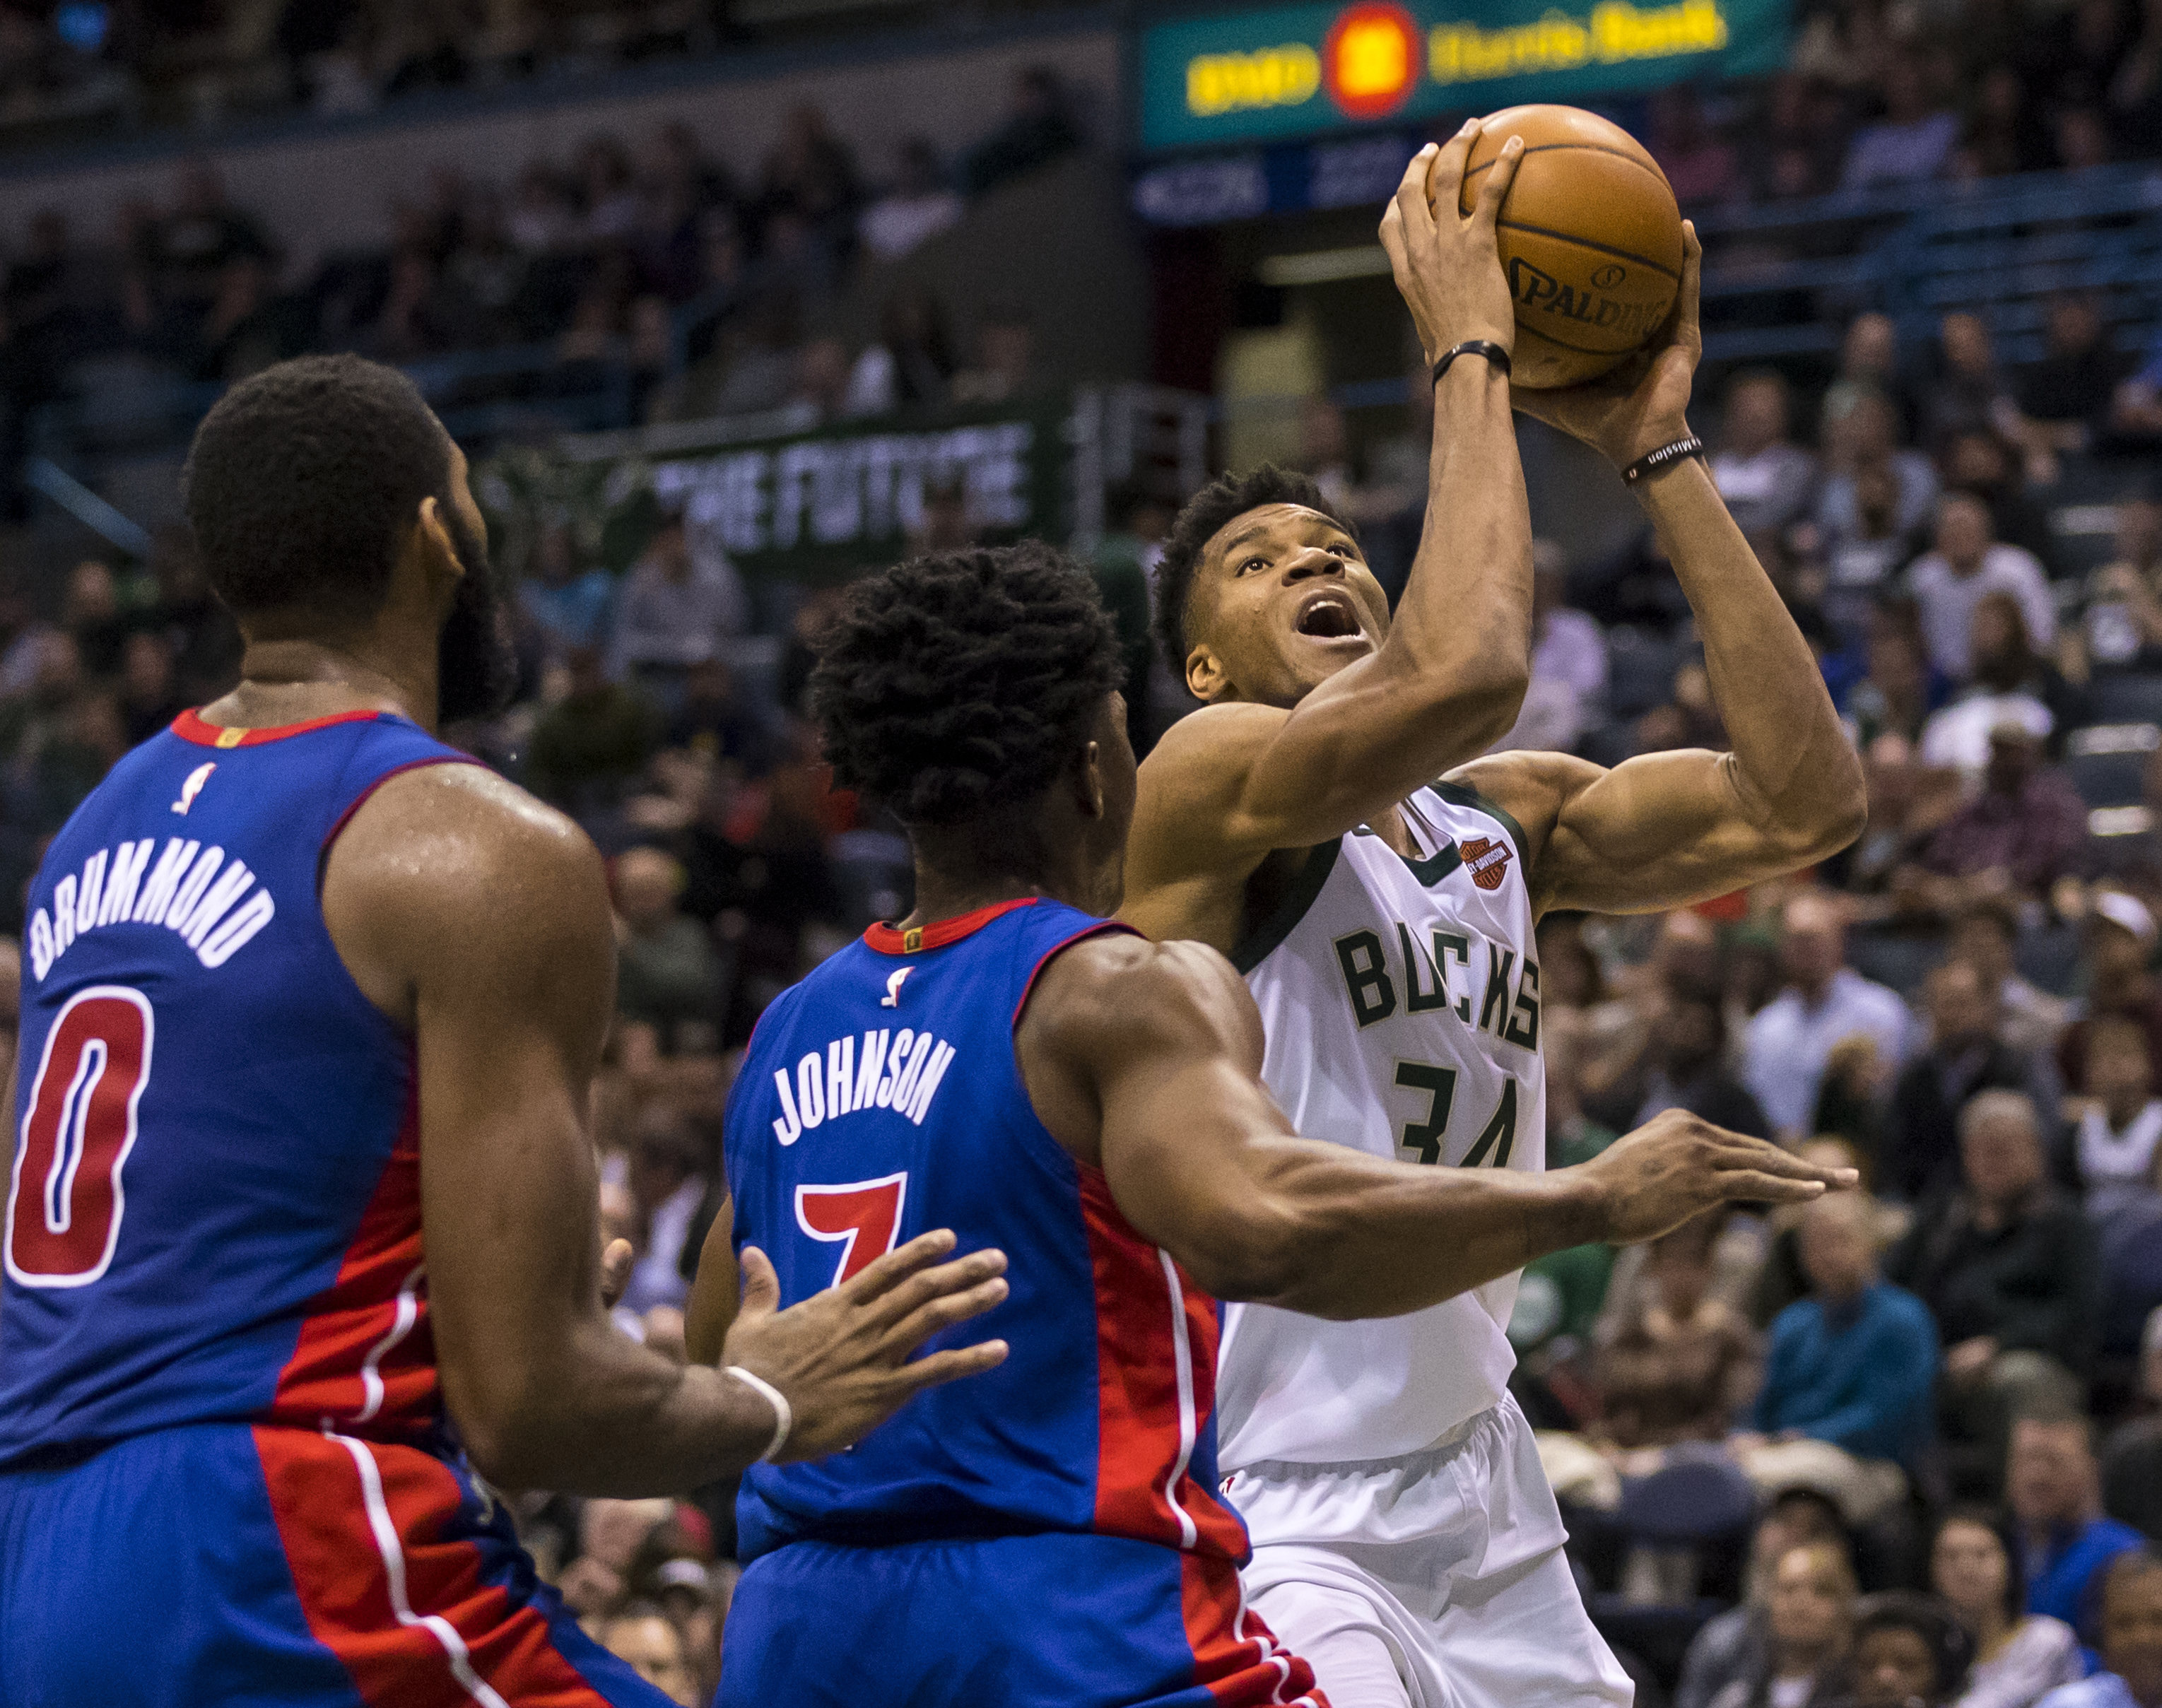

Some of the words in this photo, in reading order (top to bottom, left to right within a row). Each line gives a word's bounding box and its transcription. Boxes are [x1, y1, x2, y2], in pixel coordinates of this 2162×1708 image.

[1510, 257, 1667, 341] SPALDING
[30, 837, 276, 982] DRUMMOND
[1333, 921, 1540, 1053] BUCKS
[4, 985, 155, 1288] 0
[772, 1028, 956, 1146] JOHNSON
[1393, 1058, 1517, 1167] 34
[794, 1171, 908, 1291] 7
